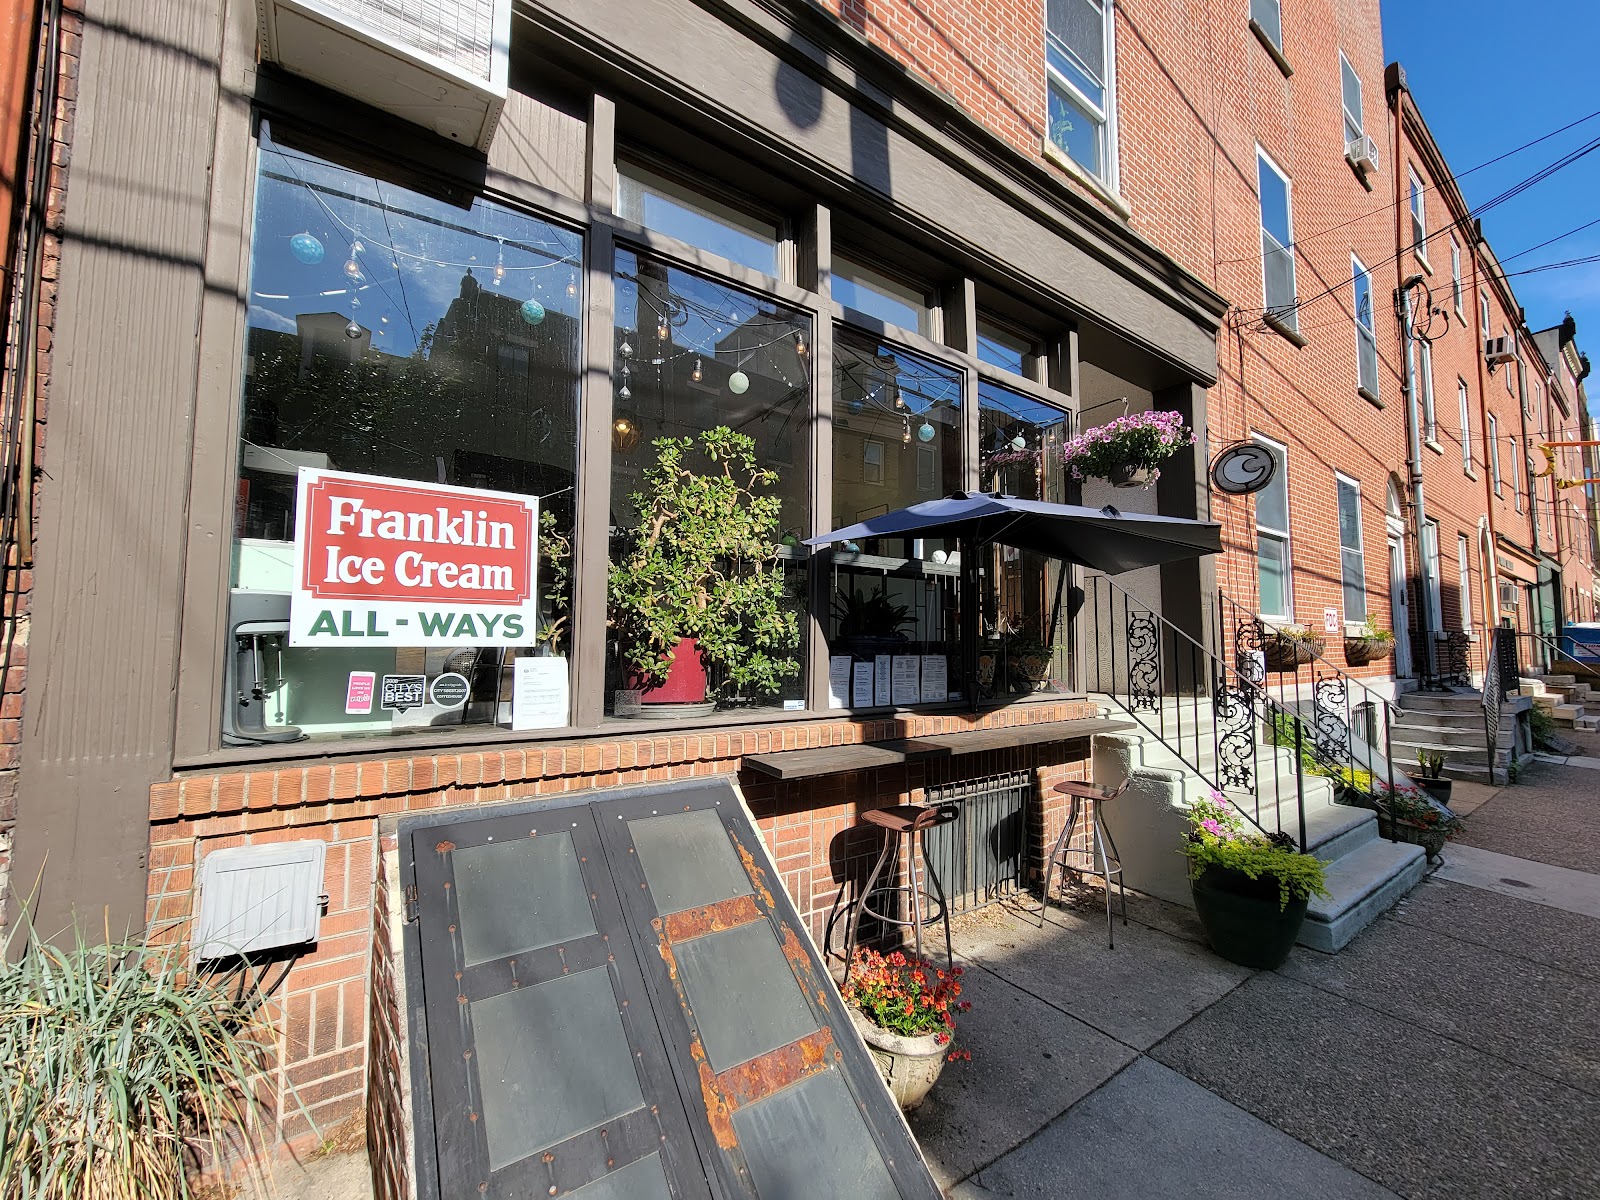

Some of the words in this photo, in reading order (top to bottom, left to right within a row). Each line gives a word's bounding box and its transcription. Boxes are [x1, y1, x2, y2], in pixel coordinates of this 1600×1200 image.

[325, 495, 516, 550] Franklin
[323, 545, 385, 584] Ice
[394, 550, 515, 591] Cream
[1325, 613, 1336, 627] FDC
[385, 683, 422, 692] CITY'S
[384, 692, 422, 702] BEST
